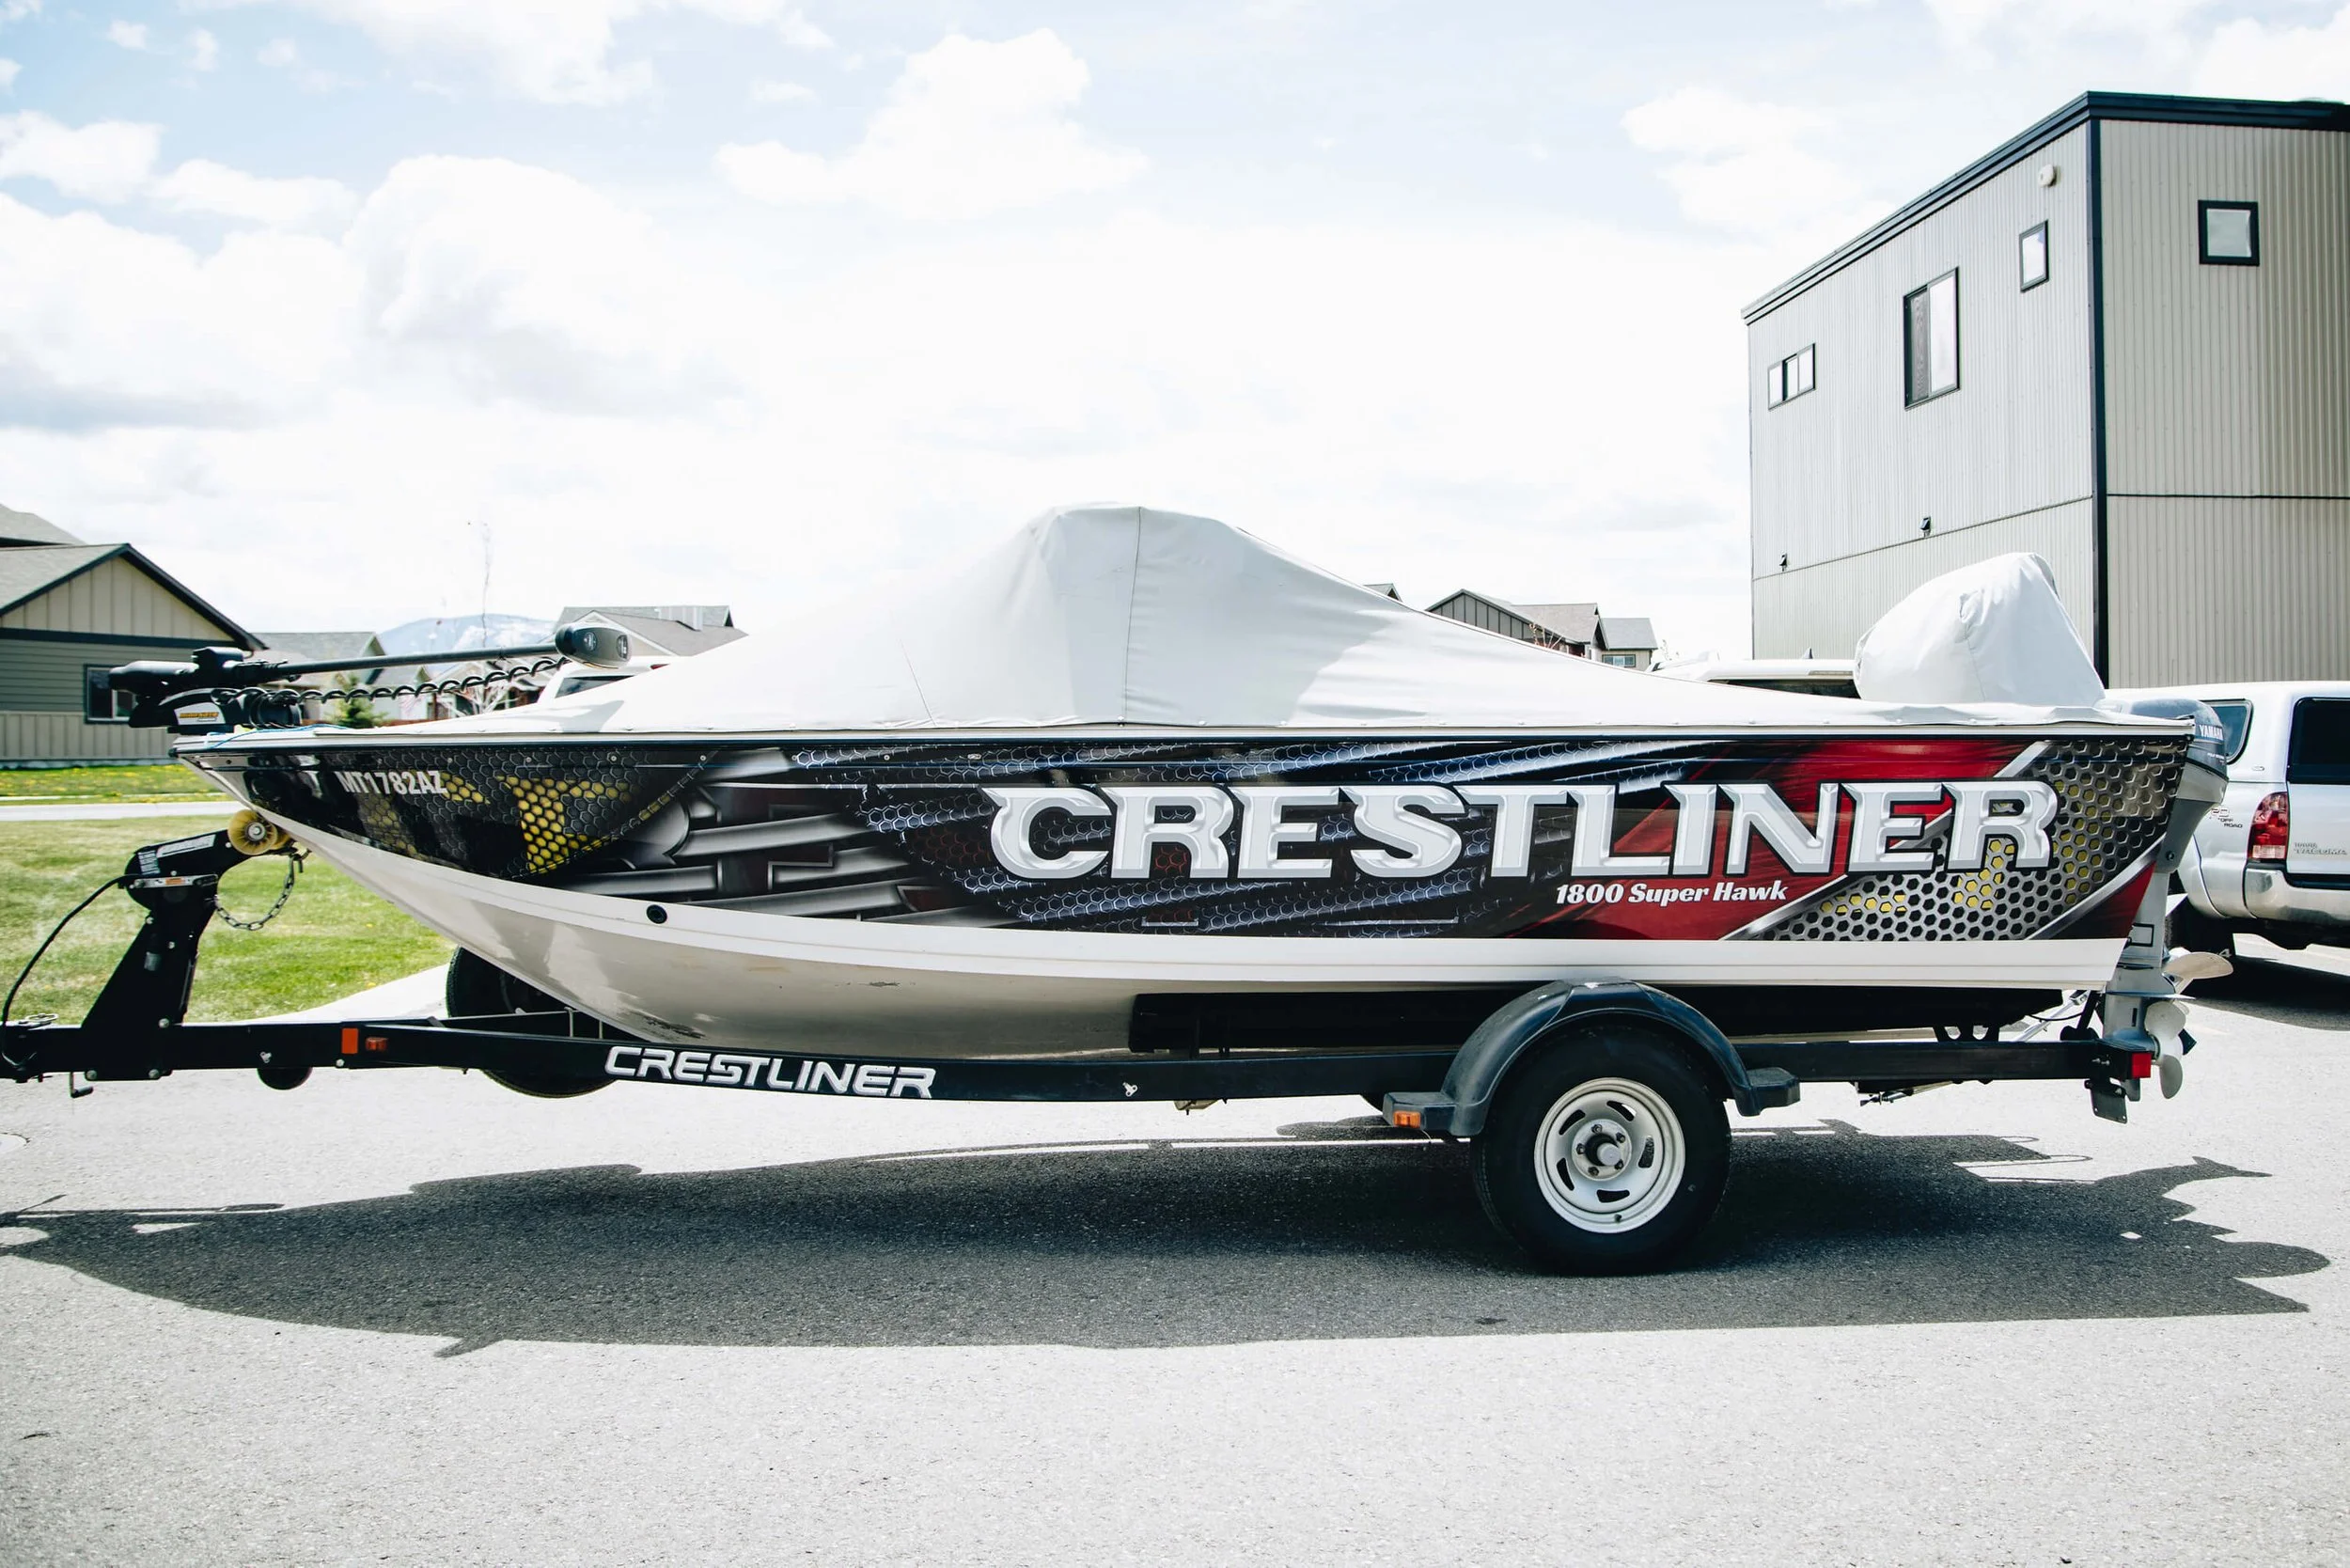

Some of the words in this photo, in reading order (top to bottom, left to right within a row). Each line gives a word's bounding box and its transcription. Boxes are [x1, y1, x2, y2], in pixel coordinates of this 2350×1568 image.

[2199, 724, 2224, 741] YAMAHA
[334, 770, 448, 795] MT1782AZ
[980, 780, 2059, 879] CRESTLINER
[1557, 883, 1624, 904] 1800
[1628, 882, 1709, 907] Super
[1713, 880, 1788, 902] Hawk
[604, 1045, 936, 1099] CRESTLINER
